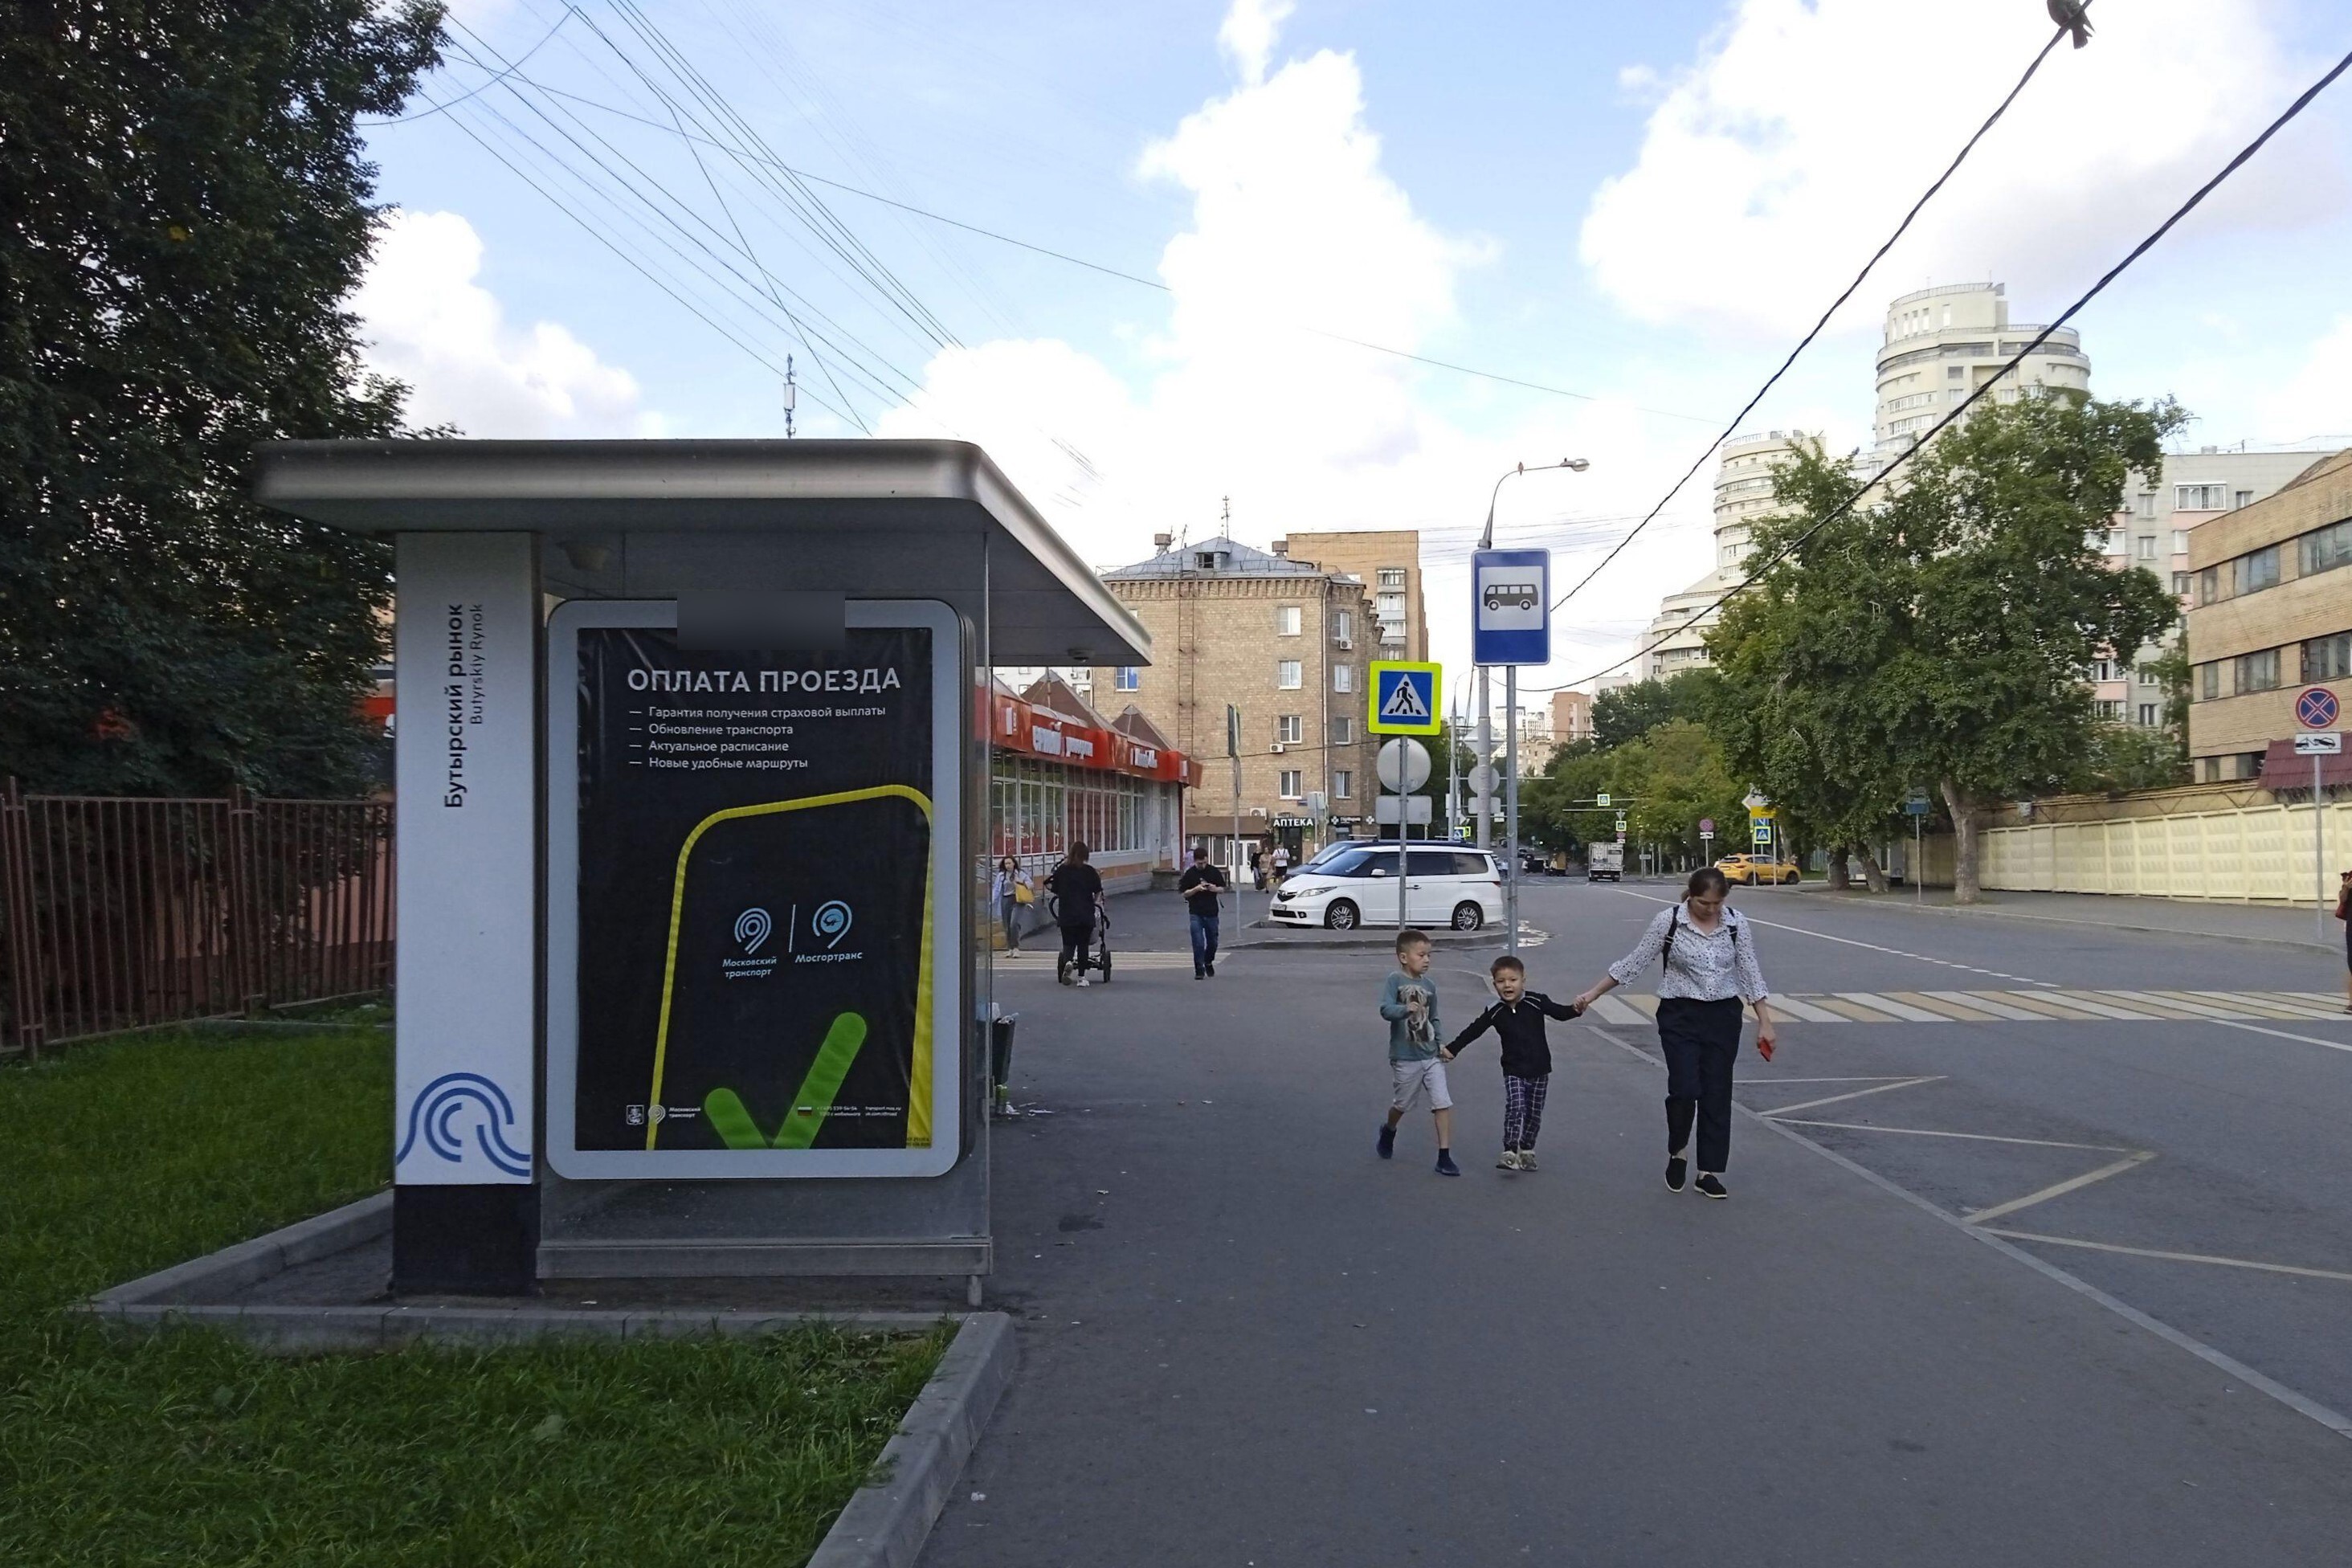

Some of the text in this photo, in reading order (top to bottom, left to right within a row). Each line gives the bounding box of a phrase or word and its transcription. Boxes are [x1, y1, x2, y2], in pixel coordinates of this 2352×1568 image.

[469, 604, 486, 725] Butyrskiy Rynok
[627, 668, 901, 694] ОПЛАТА ПРОЕЗДА
[444, 604, 468, 807] Бутырский рынок
[648, 706, 886, 721] Гарантия получения страховой выплаты
[648, 724, 794, 737] Обновление транспорта
[648, 741, 790, 753] Актуальное расписание
[649, 757, 808, 770] Новые удобные маршруты
[1273, 819, 1314, 827] АПТЕКА
[722, 956, 778, 968] Московский
[794, 952, 864, 964] Мосгортранс
[725, 969, 772, 979] транспорт
